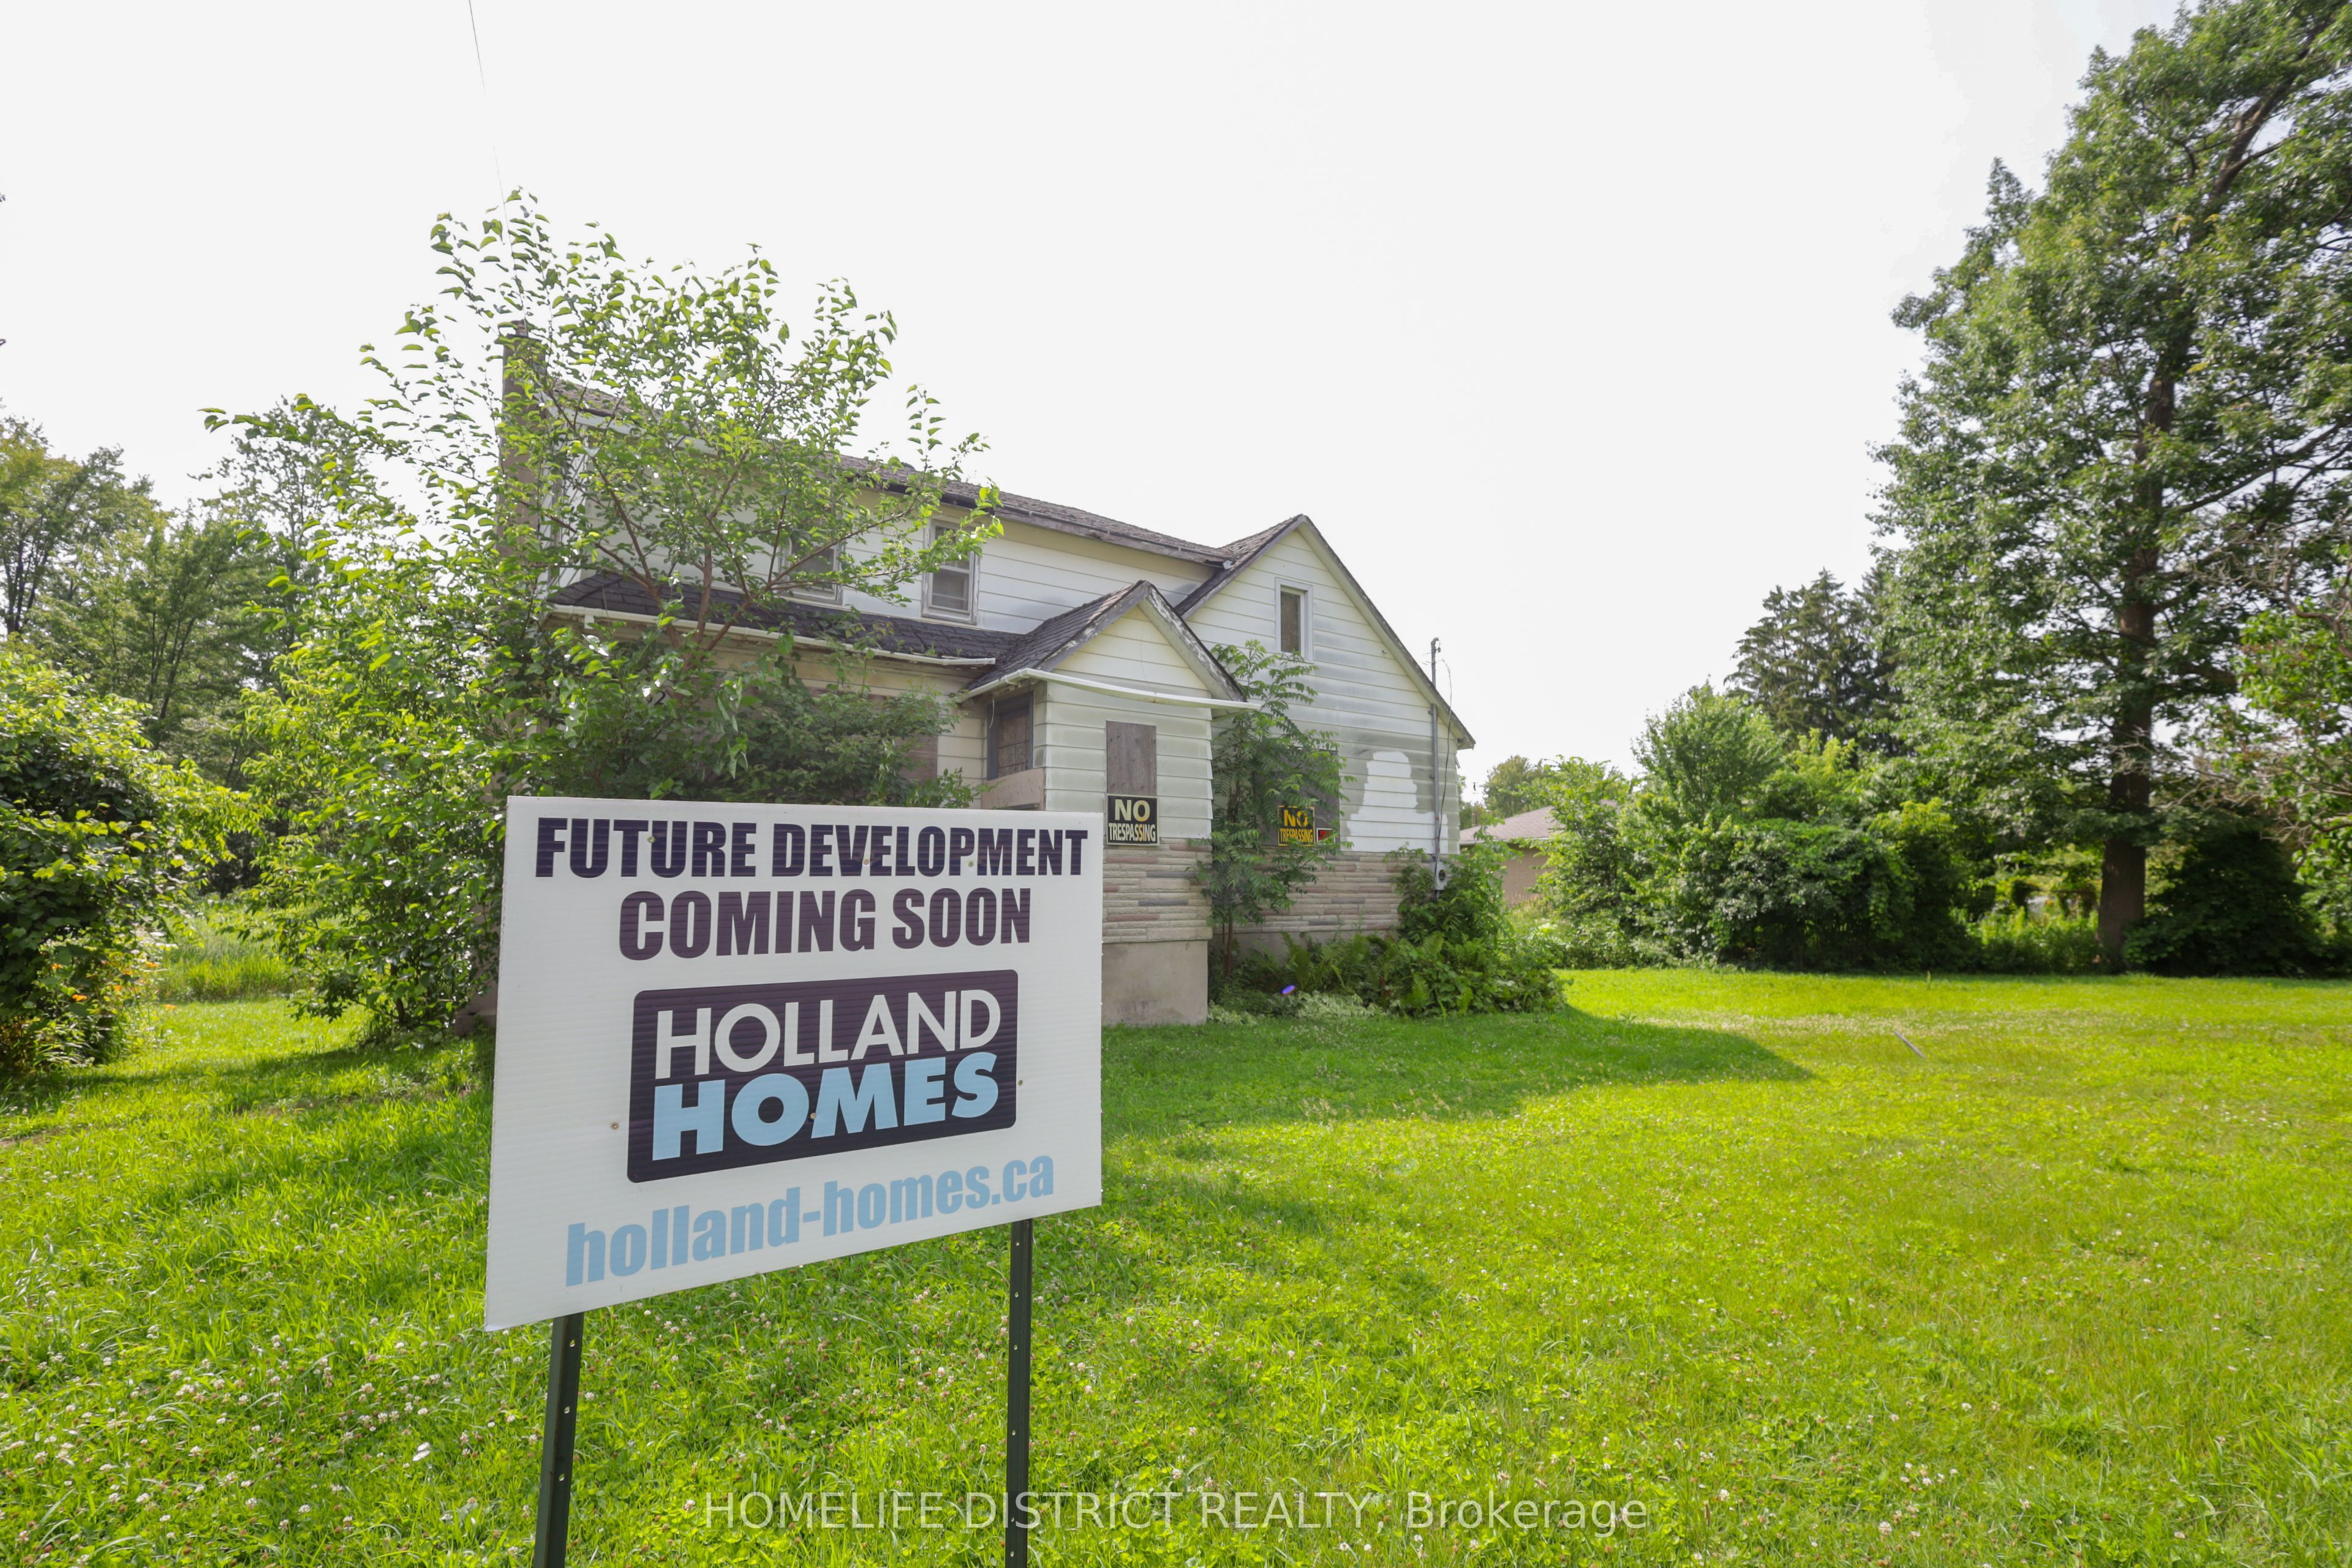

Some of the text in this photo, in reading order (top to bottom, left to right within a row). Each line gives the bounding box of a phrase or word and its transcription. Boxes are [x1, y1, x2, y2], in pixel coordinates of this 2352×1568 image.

[1108, 823, 1156, 842] TRESPASSING
[1115, 799, 1150, 822] NO
[1280, 828, 1313, 843] TRESPASSING
[1284, 809, 1309, 827] NO
[535, 818, 1088, 878] FUTURE DEVELOPMENT
[619, 888, 1030, 960] COMING SOON
[655, 990, 1000, 1079] HOLLAND
[652, 1052, 998, 1161] HOMES
[566, 1156, 1054, 1286] holland-homes.ca
